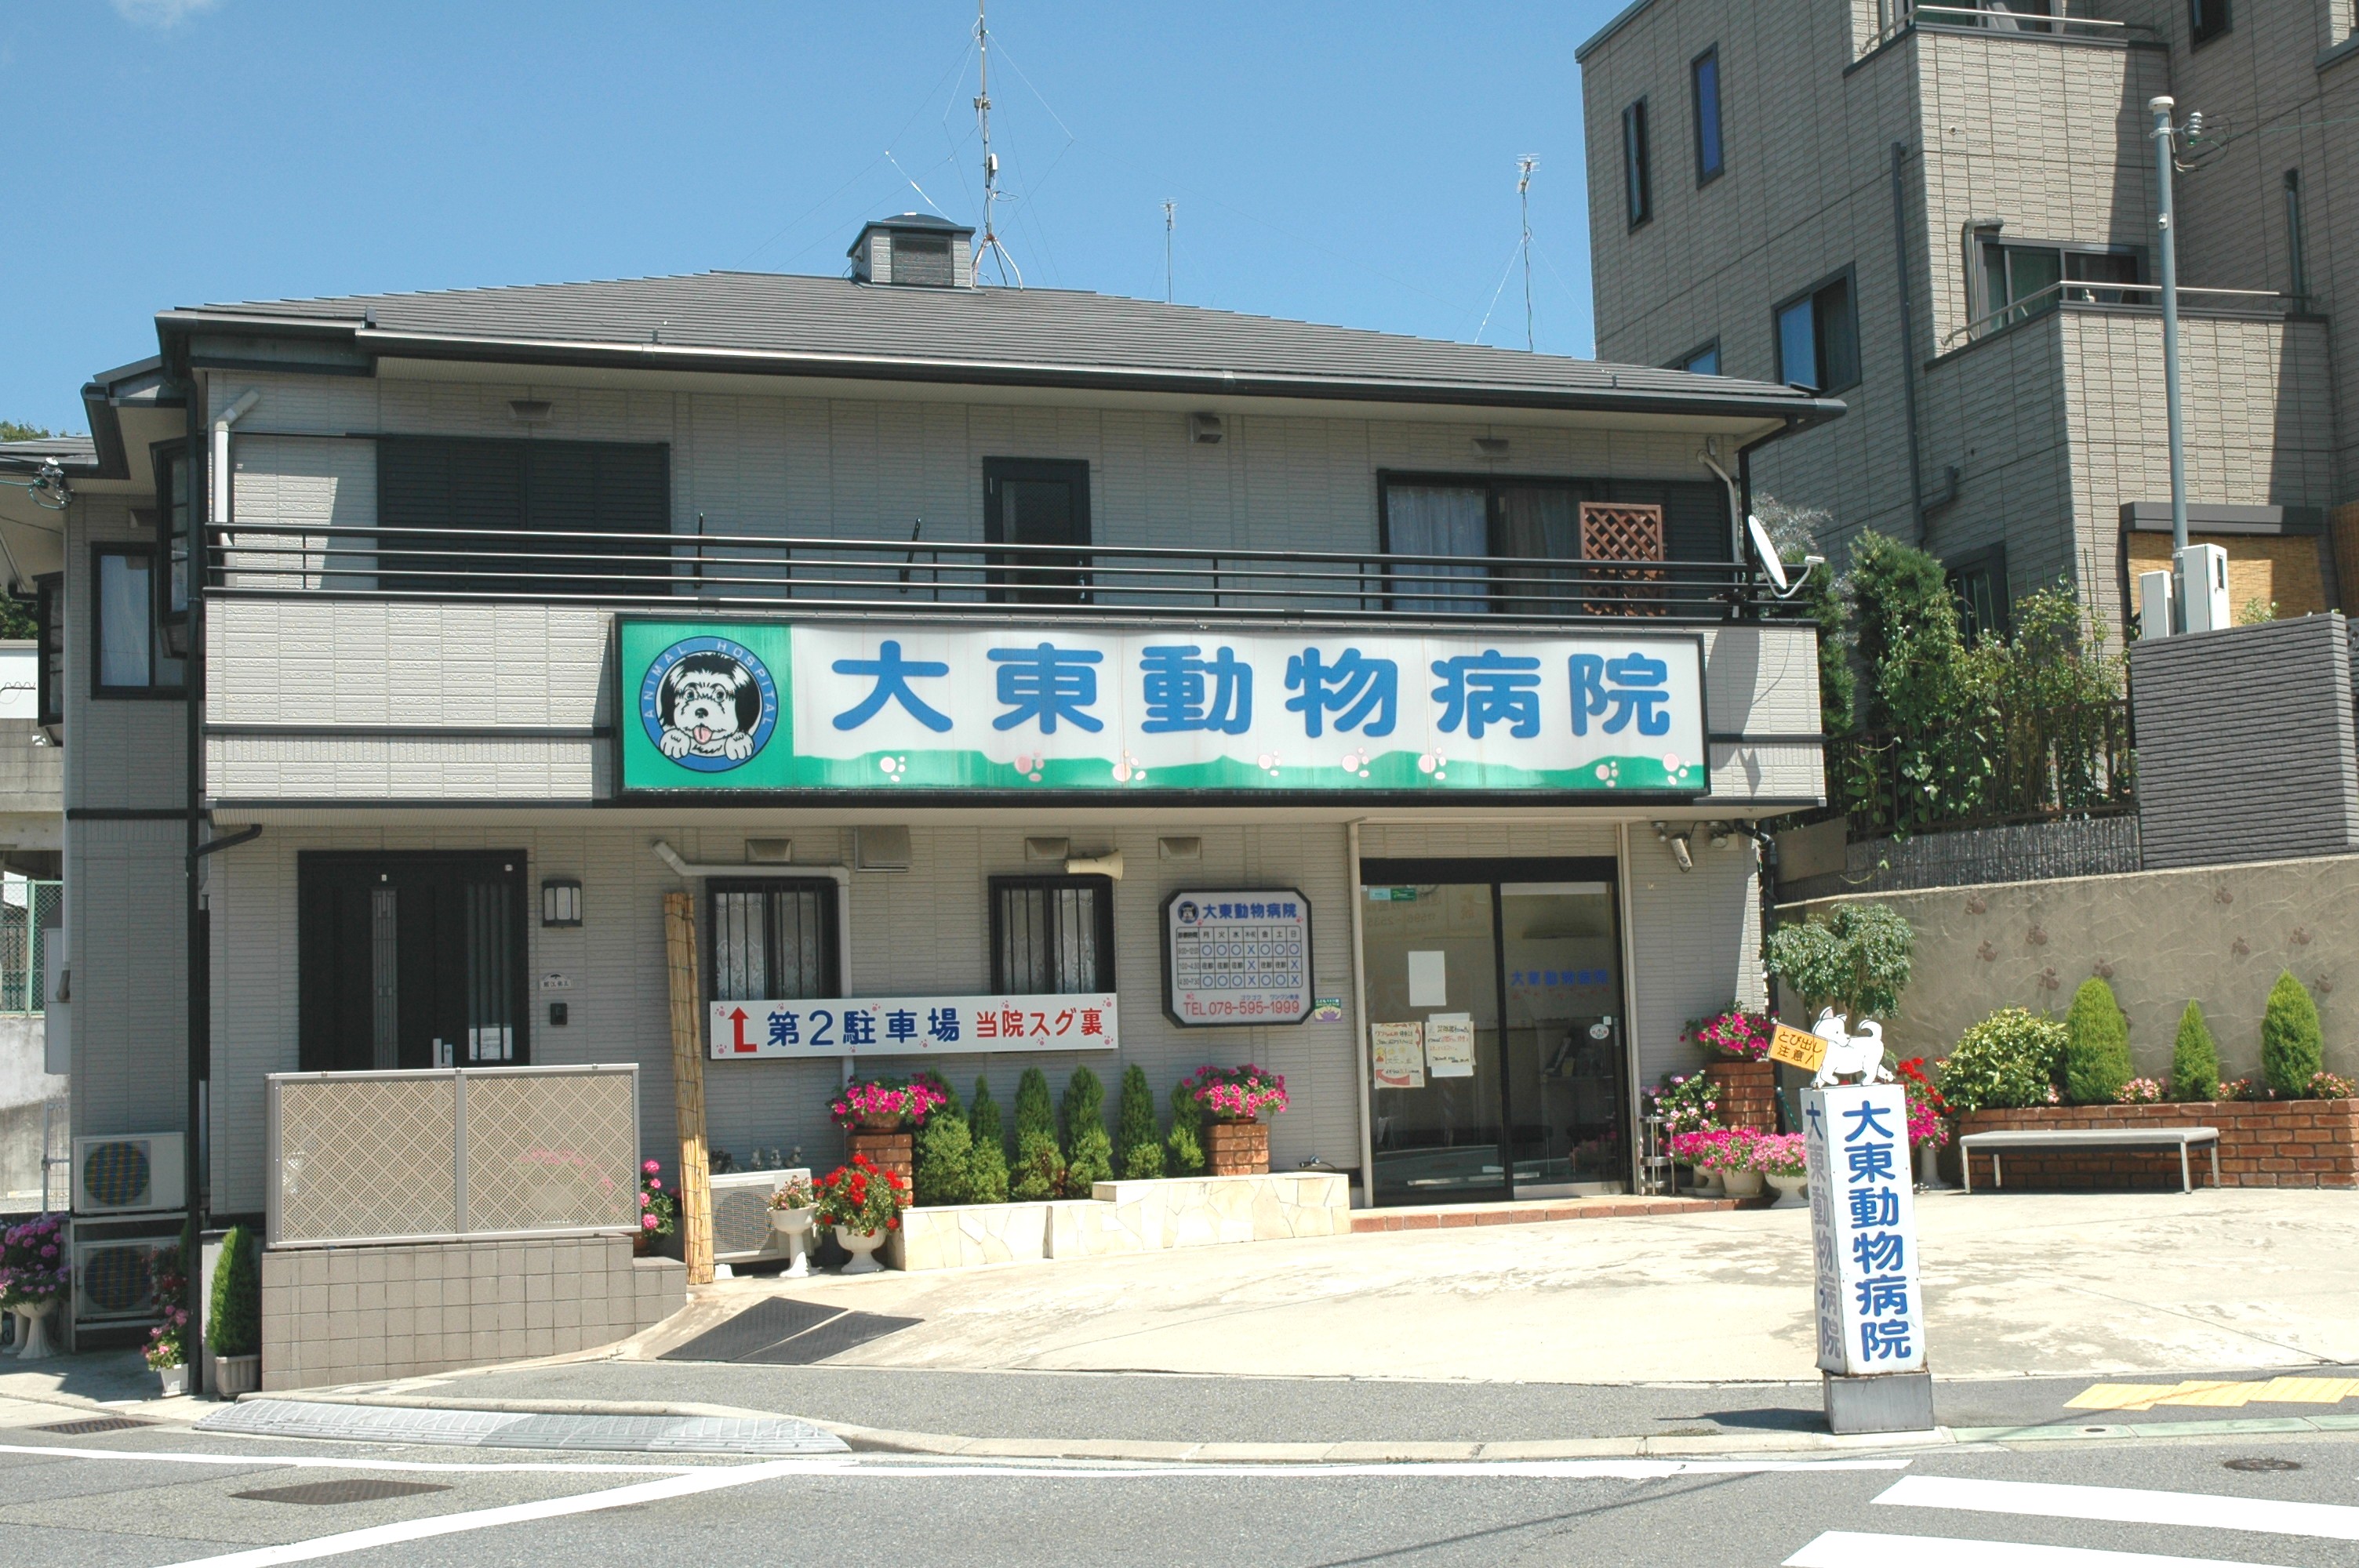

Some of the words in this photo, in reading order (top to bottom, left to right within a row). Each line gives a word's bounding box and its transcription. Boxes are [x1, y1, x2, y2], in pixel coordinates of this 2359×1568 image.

[645, 645, 688, 719] ANIMAL
[717, 641, 776, 724] HOSPITAL
[831, 640, 1671, 739] 大東動物病院
[1202, 902, 1297, 920] 大東動物病院
[1202, 931, 1210, 939] 月
[1218, 931, 1227, 939] 火
[1232, 931, 1241, 939] 水
[1261, 930, 1269, 938] 金
[1276, 930, 1284, 938] 土
[1290, 930, 1298, 938] 日
[766, 1007, 961, 1047] 第2駐車場
[976, 1007, 1103, 1038] 当院スグ裏
[1183, 1002, 1206, 1016] TEL
[1209, 1000, 1300, 1015] 078-595-1999
[1778, 1031, 1823, 1054] とび出し
[1805, 1101, 1841, 1360] 大東動物病院
[1842, 1100, 1912, 1363] 大東動物病院
